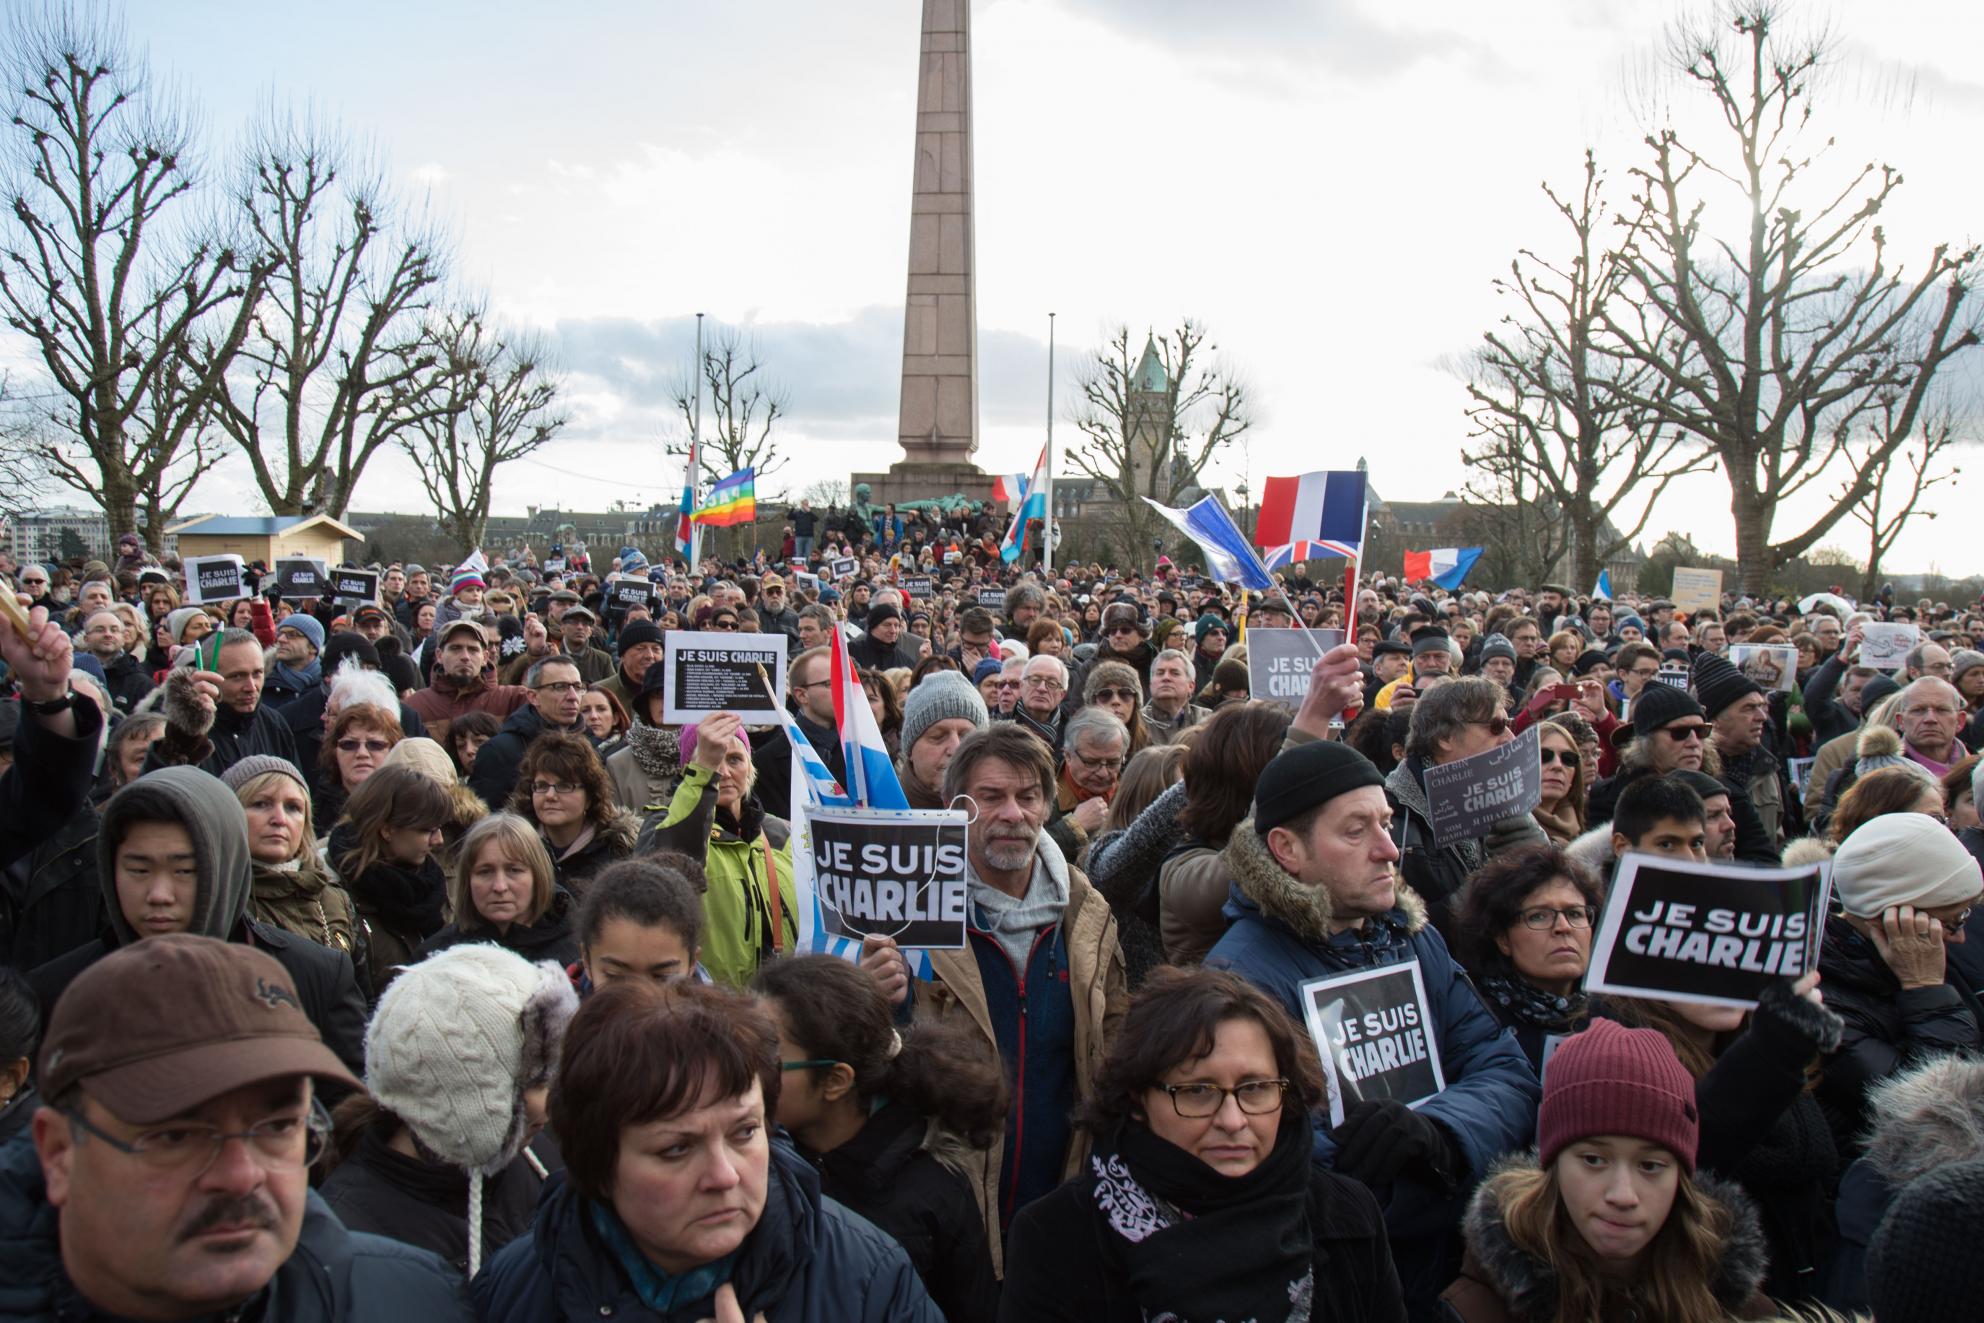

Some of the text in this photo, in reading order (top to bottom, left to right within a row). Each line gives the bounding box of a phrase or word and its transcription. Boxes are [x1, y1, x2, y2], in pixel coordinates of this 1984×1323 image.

[200, 575, 238, 588] CHARLIE
[213, 568, 236, 578] SUIS
[340, 584, 366, 594] CHARLIE
[679, 651, 774, 664] JE SUIS CHARLIE
[1268, 657, 1318, 672] JE SU
[1269, 675, 1312, 696] CHAR
[1432, 769, 1474, 788] CHARLIE
[1462, 766, 1522, 798] JE SUIS
[1464, 778, 1525, 813] CHARLIE
[817, 840, 964, 874] JE SUIS
[820, 873, 965, 921] CHARLIE
[1634, 901, 1806, 939] JE SUIS
[1625, 924, 1804, 976] CHARLIE
[1333, 1003, 1418, 1045] JE SUIS
[1340, 1028, 1426, 1082] CHARLIE
